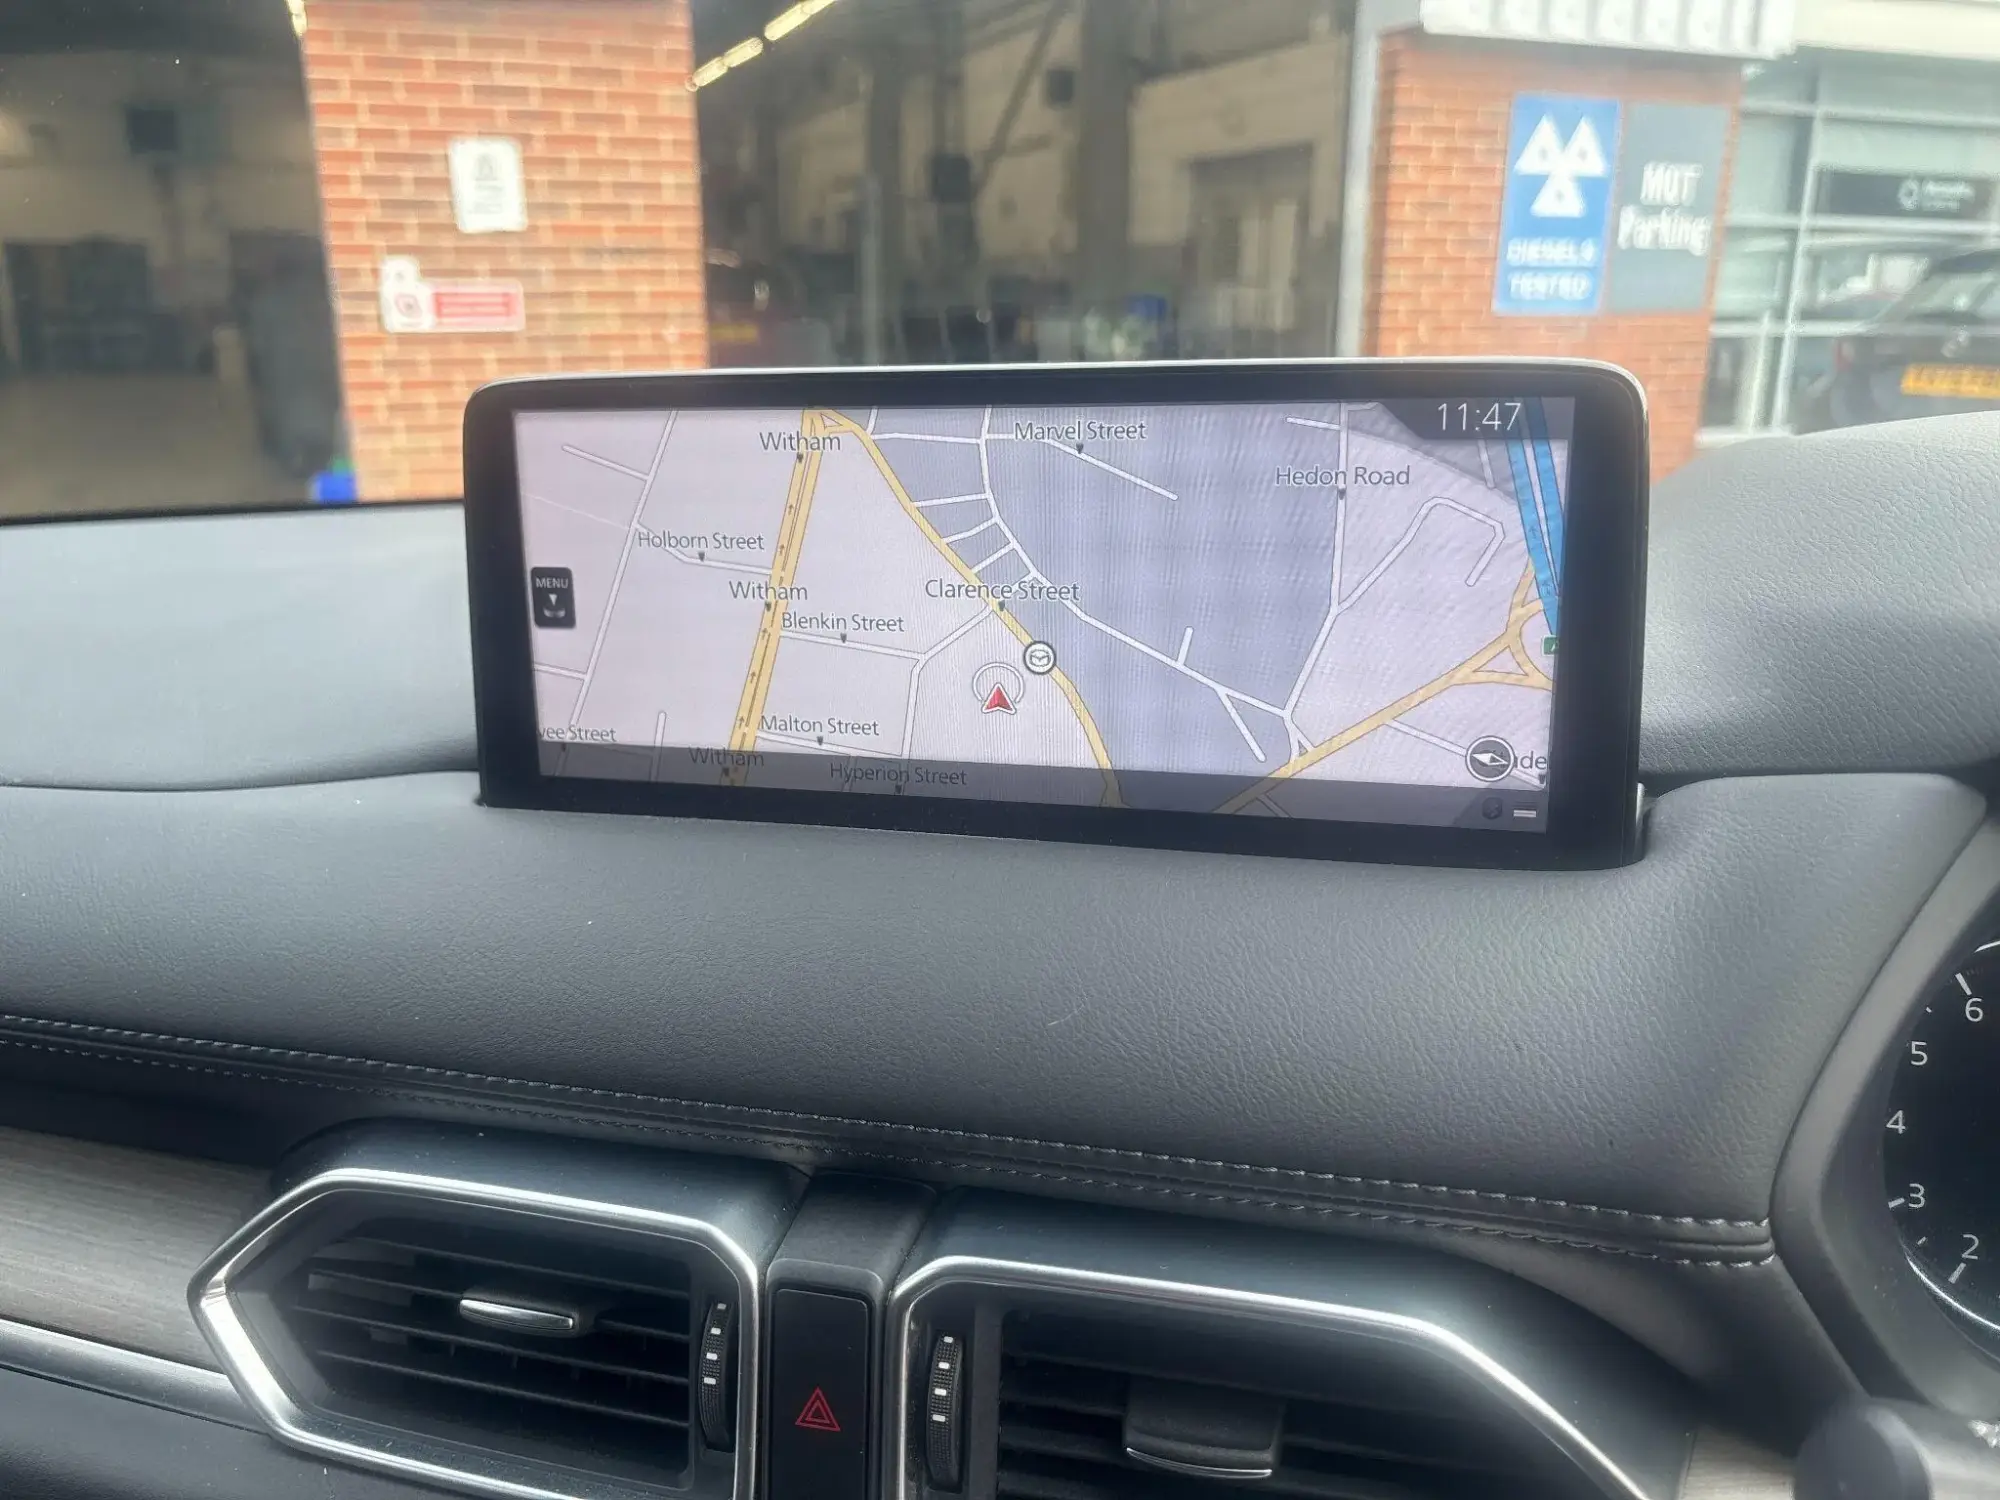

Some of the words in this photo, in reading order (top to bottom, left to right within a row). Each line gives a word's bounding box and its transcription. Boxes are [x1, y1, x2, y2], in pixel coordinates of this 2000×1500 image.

[1641, 162, 1703, 206] MOT
[1618, 205, 1711, 256] Parking
[1438, 402, 1522, 432] 11:47
[760, 430, 841, 451] Witham
[1015, 420, 1081, 440] Marvel
[1087, 421, 1147, 440] Street
[1276, 466, 1347, 486] Hedon
[1354, 465, 1411, 486] Road
[638, 530, 708, 549] Holborn
[712, 532, 765, 550] Street
[535, 577, 569, 589] MENU
[729, 580, 808, 600] Witham
[925, 578, 1012, 600] Clarence
[1018, 580, 1080, 601] Street
[782, 611, 848, 630] Blenkin
[851, 614, 905, 633] Street
[568, 724, 617, 742] Street
[761, 715, 823, 733] Malton
[827, 717, 880, 737] Street
[688, 746, 765, 767] Witham
[830, 763, 910, 783] Hyperion
[914, 769, 967, 786] Street
[1965, 997, 1984, 1022] 6
[1910, 1040, 1928, 1066] 5
[1886, 1110, 1907, 1134] 4
[1908, 1183, 1926, 1209] 3
[1961, 1233, 1980, 1260] 2
